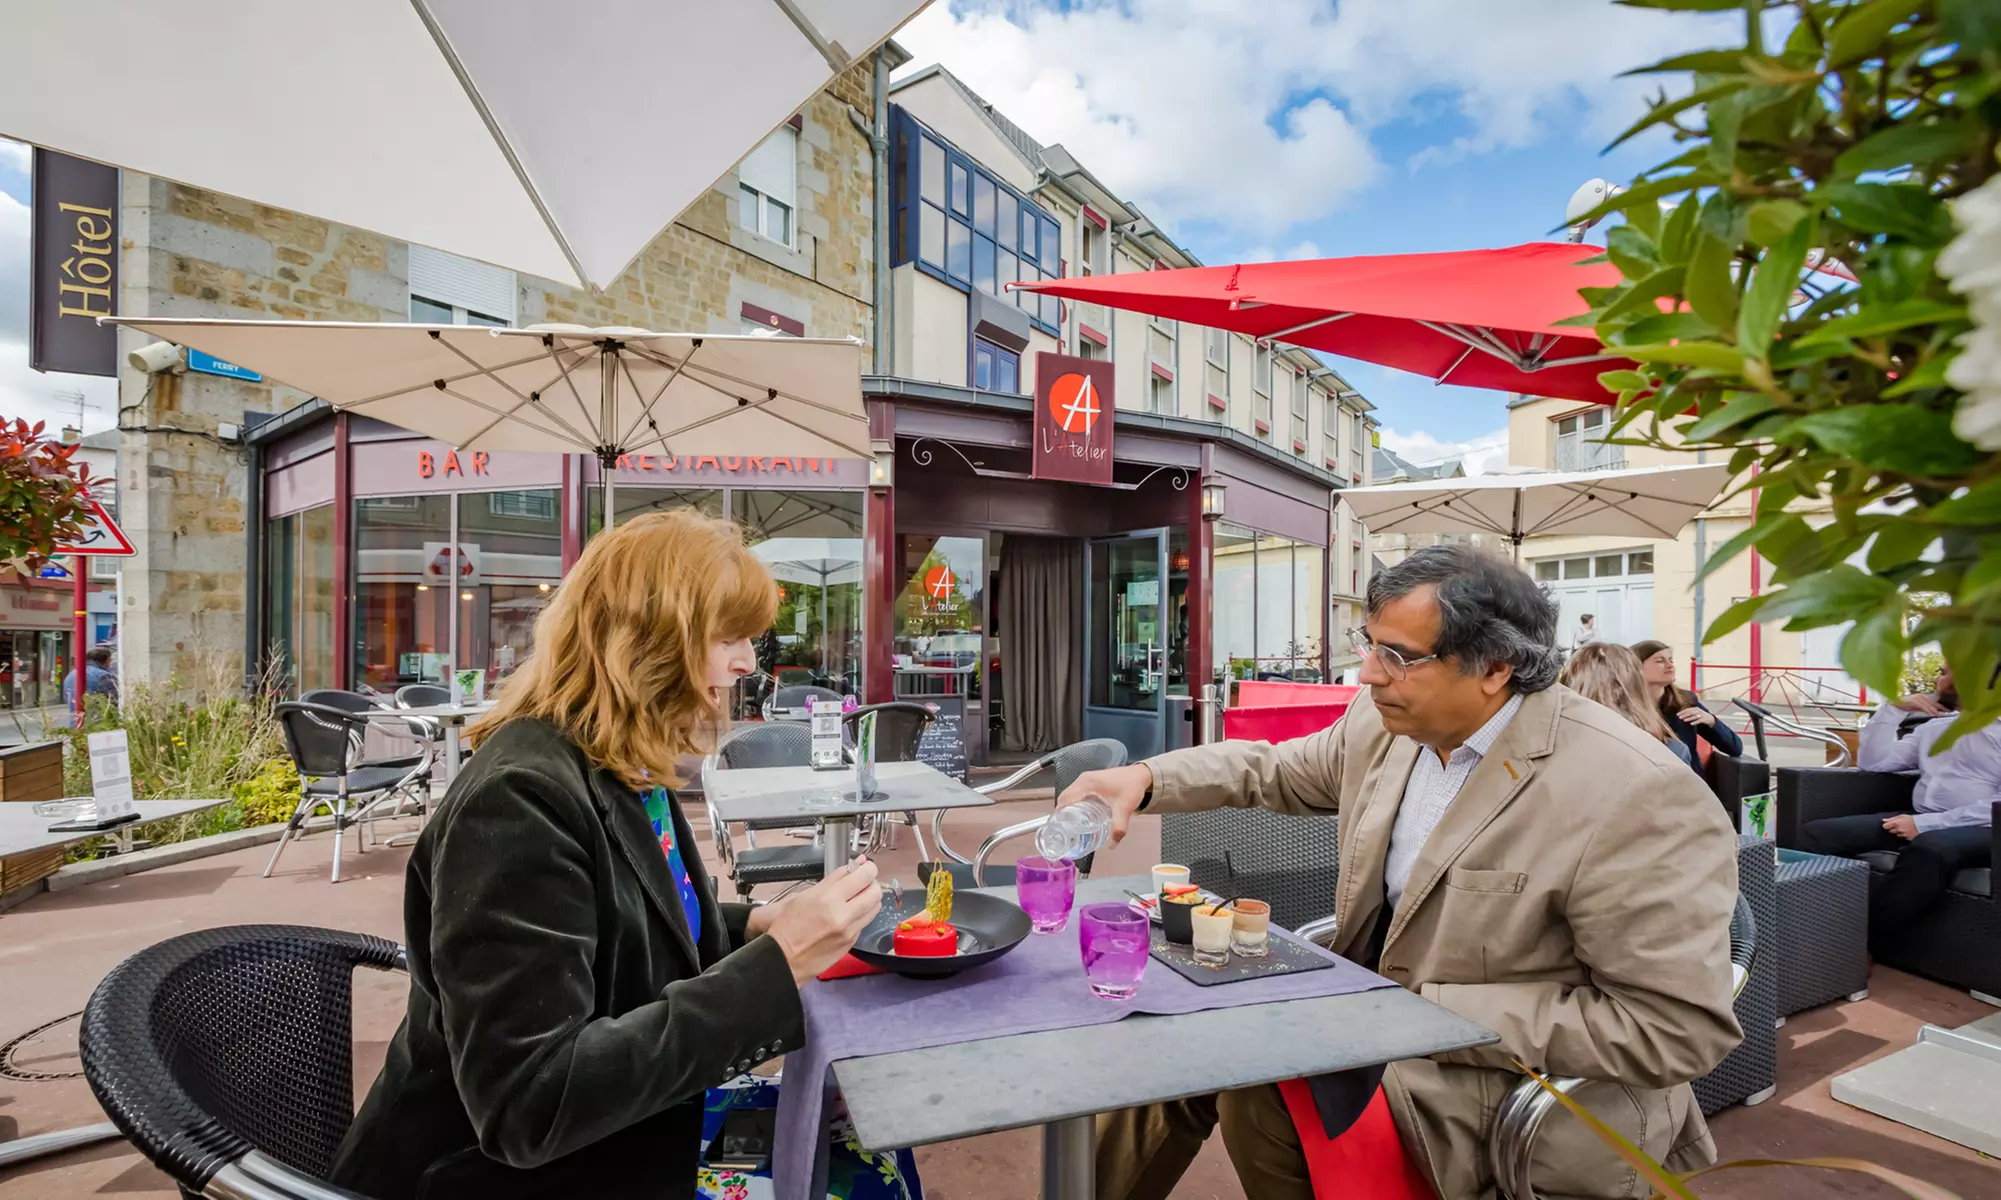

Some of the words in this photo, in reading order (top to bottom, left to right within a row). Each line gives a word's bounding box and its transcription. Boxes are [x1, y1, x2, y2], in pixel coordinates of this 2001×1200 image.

[58, 202, 112, 319] Hôtel
[212, 361, 240, 372] FERRY
[1042, 427, 1107, 461] L'Atelier
[419, 449, 488, 477] BAR
